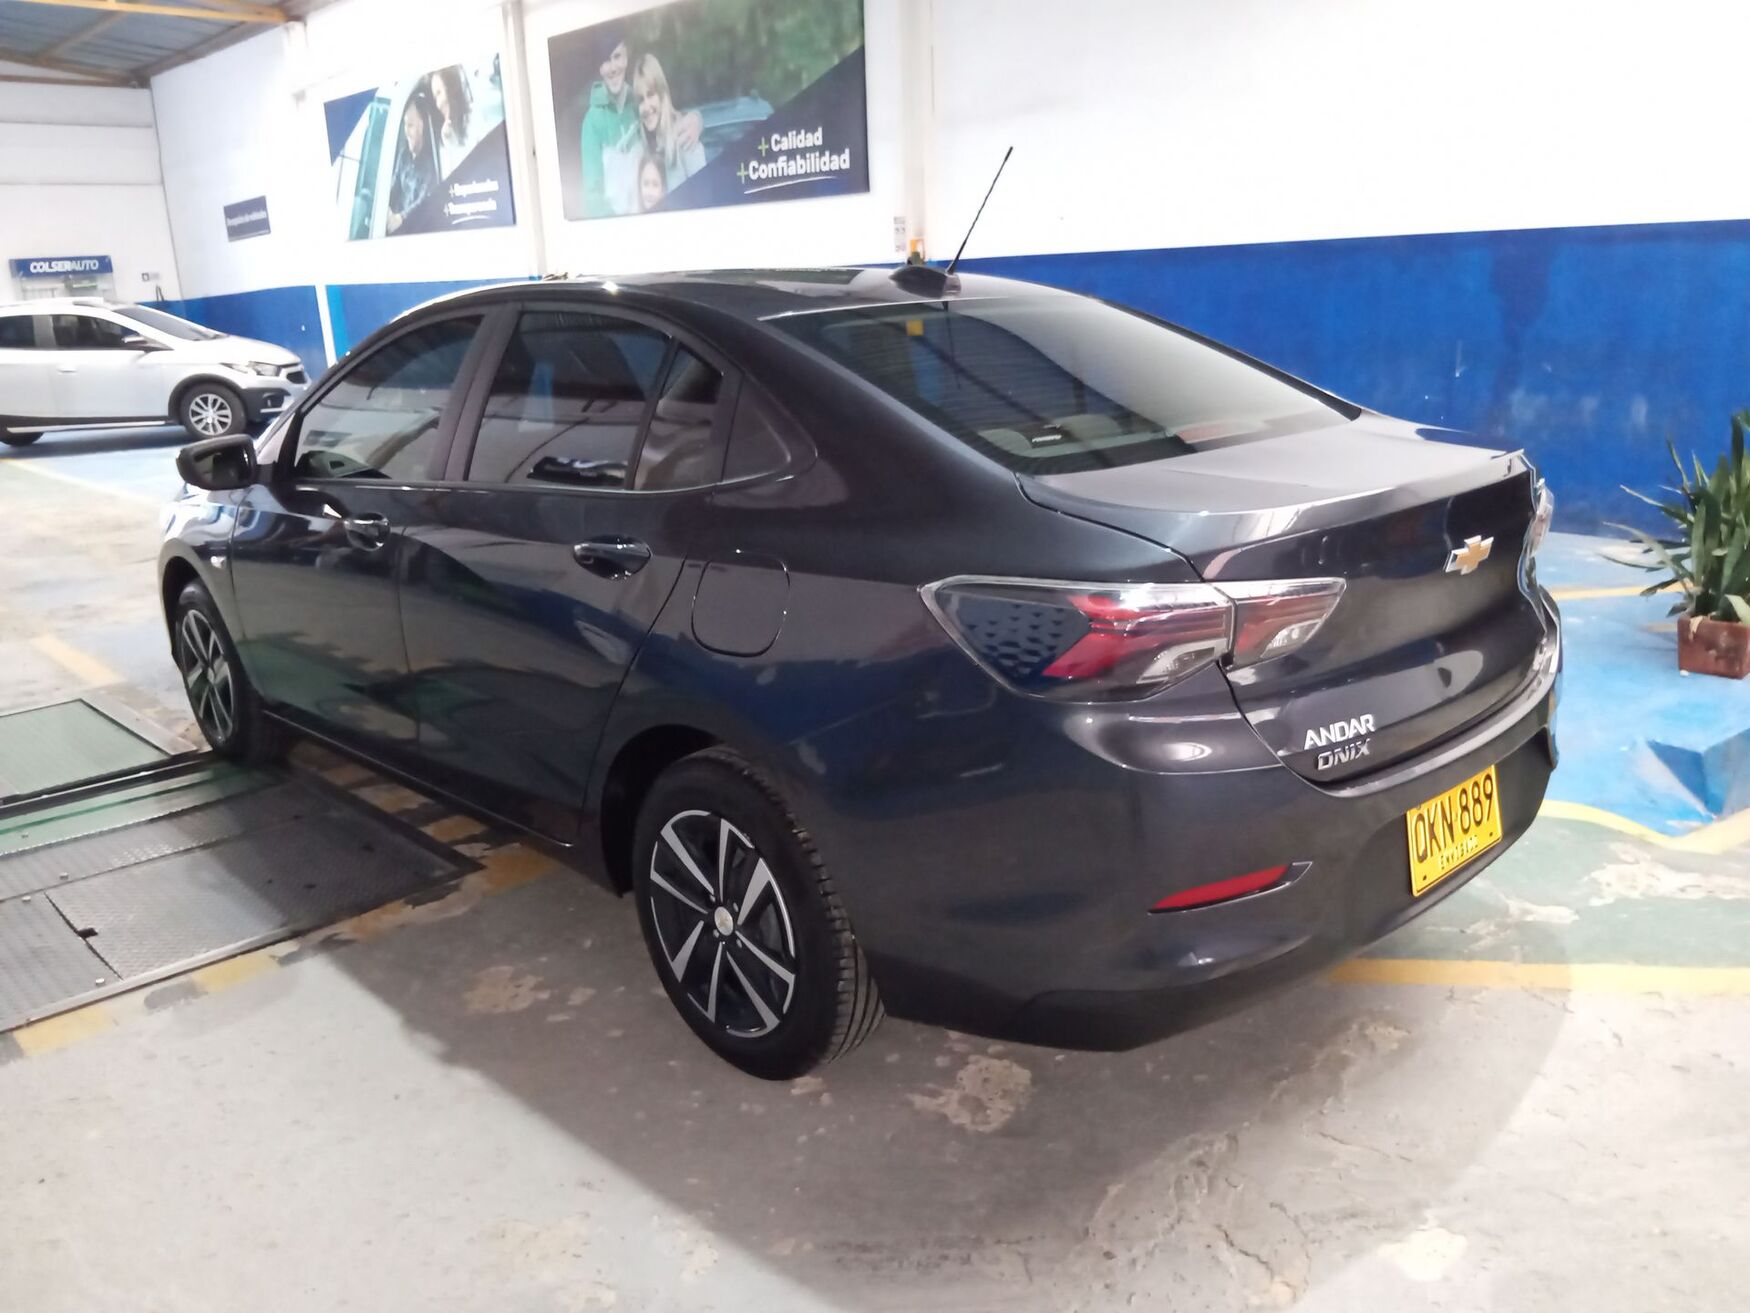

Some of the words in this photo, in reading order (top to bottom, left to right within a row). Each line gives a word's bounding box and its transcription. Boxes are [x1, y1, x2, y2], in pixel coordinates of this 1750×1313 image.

[771, 126, 823, 152] Calidad
[29, 259, 99, 273] COLSERAUTO
[1304, 713, 1375, 750] ANDAR
[1317, 738, 1371, 770] ONIX
[1459, 773, 1493, 834] 889
